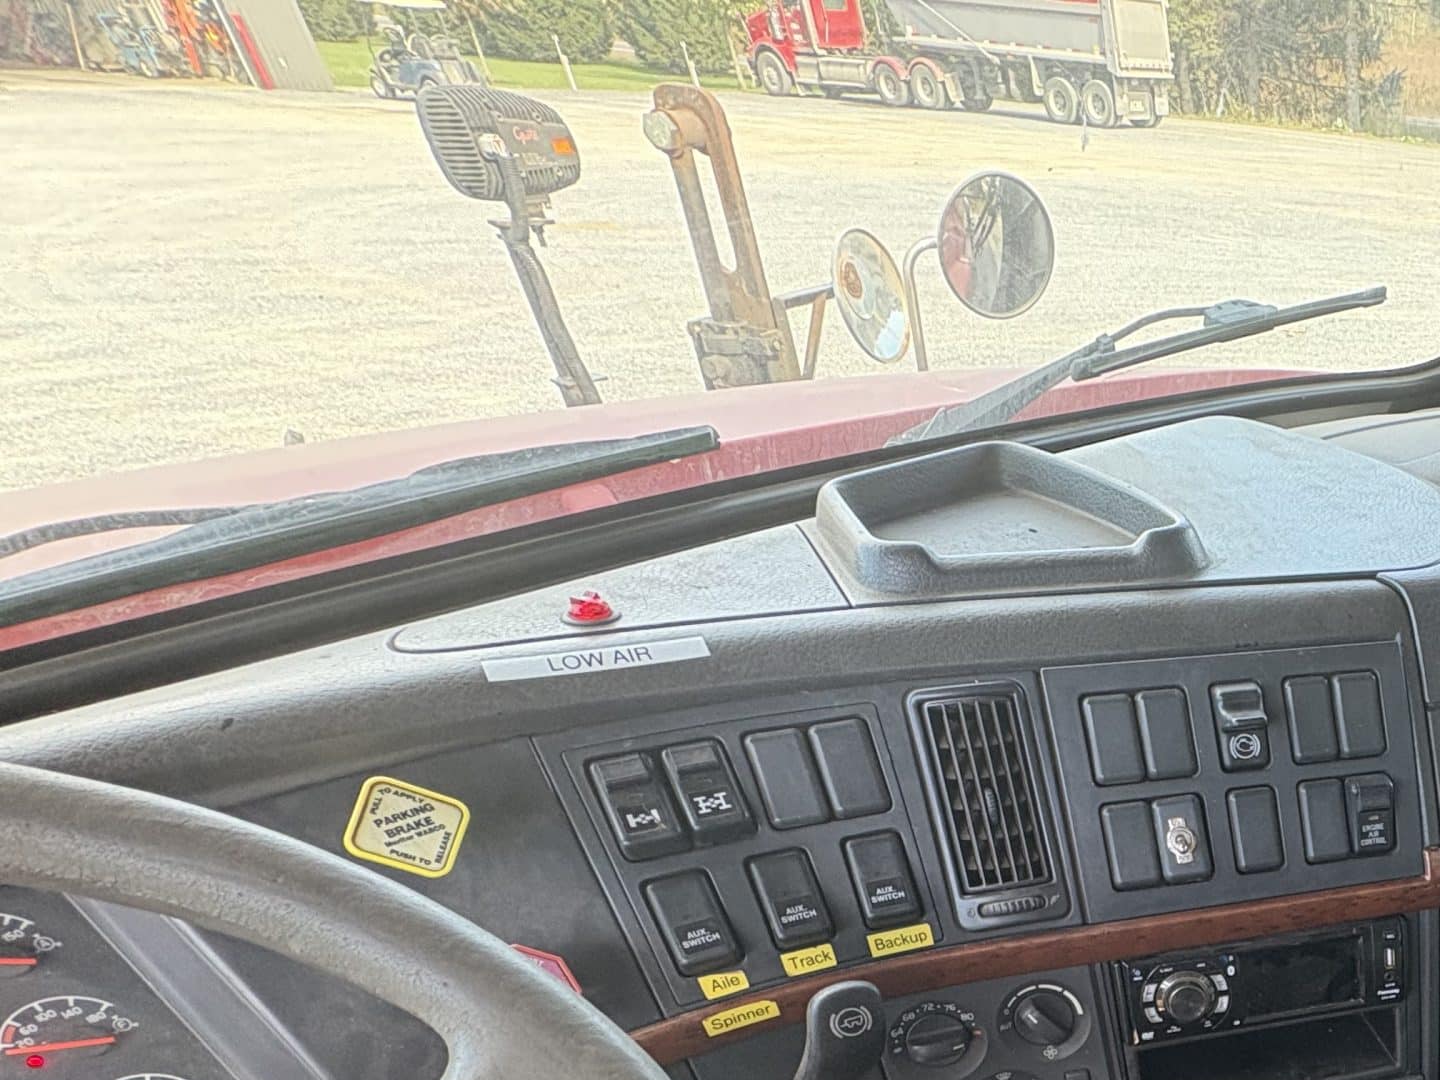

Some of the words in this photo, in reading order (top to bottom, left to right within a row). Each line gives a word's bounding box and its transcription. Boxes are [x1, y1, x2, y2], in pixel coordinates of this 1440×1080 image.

[547, 653, 604, 672] LOW
[613, 646, 653, 665] AIR
[378, 787, 392, 796] TO
[392, 790, 425, 804] APPLY
[370, 797, 383, 815] PULL
[373, 803, 436, 828] PARKING
[384, 816, 436, 839] BRAKE
[434, 831, 453, 865] RELEASE
[389, 848, 416, 862] PUSH
[418, 857, 432, 867] TO
[871, 890, 906, 904] SWITCH
[876, 886, 897, 896] AUX.
[781, 908, 817, 924] SWITCH
[786, 904, 808, 916] AUX.
[682, 932, 721, 949] SWITCH
[687, 927, 710, 940] AUX.
[874, 930, 928, 952] Backup
[788, 950, 833, 970] Track
[711, 975, 741, 993] Aile
[921, 1003, 935, 1011] 72
[944, 1003, 957, 1012] 76
[711, 1004, 771, 1032] Spinner
